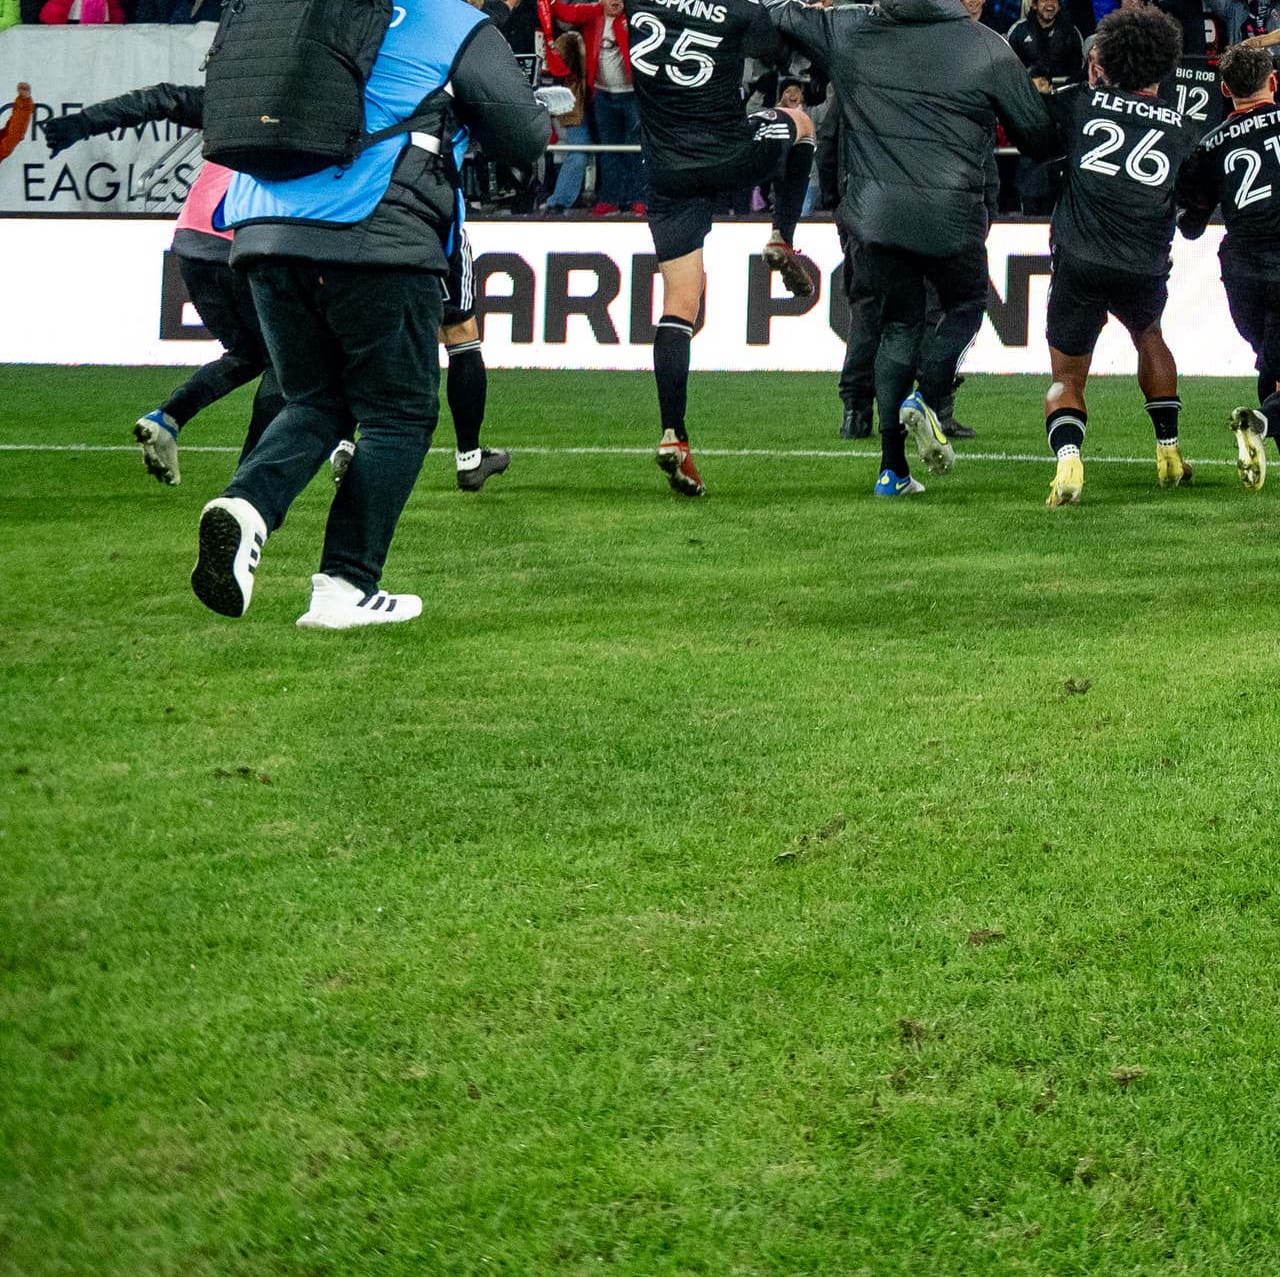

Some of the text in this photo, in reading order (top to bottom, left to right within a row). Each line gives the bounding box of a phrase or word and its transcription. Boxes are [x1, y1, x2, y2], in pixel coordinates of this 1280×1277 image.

[629, 11, 724, 88] 25
[1175, 67, 1216, 82] BIG ROB
[1091, 91, 1183, 128] FLETCHER
[1175, 83, 1210, 121] 12
[1079, 118, 1171, 187] 26
[23, 161, 195, 203] EAGLES
